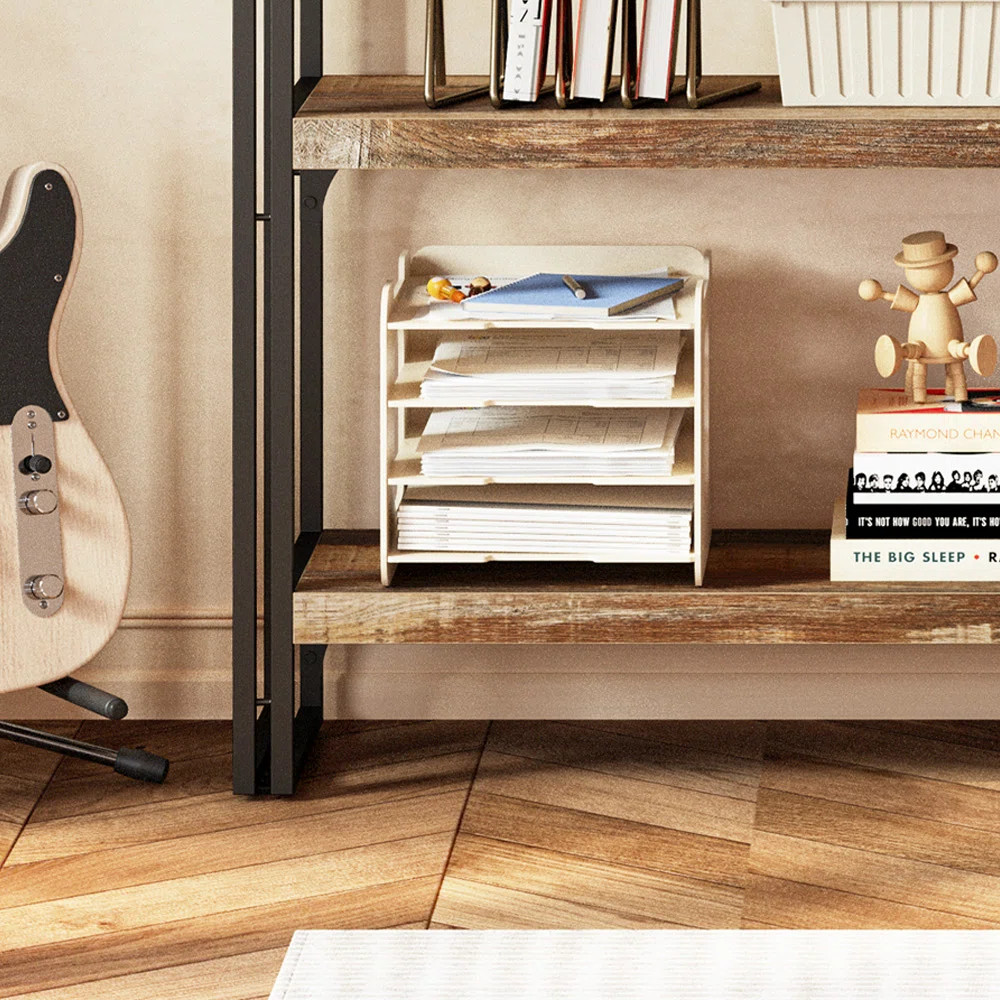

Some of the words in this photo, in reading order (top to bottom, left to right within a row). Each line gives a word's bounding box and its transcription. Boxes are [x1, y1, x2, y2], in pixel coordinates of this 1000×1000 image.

[890, 428, 959, 440] RAYMOND
[875, 516, 891, 527] NOT
[892, 516, 910, 527] HOW
[912, 516, 932, 527] GOOD
[935, 516, 950, 527] YOU
[952, 516, 970, 528] ARE,
[853, 551, 881, 563] THE
[888, 551, 916, 563] BIG
[922, 551, 966, 563] SLEEP
